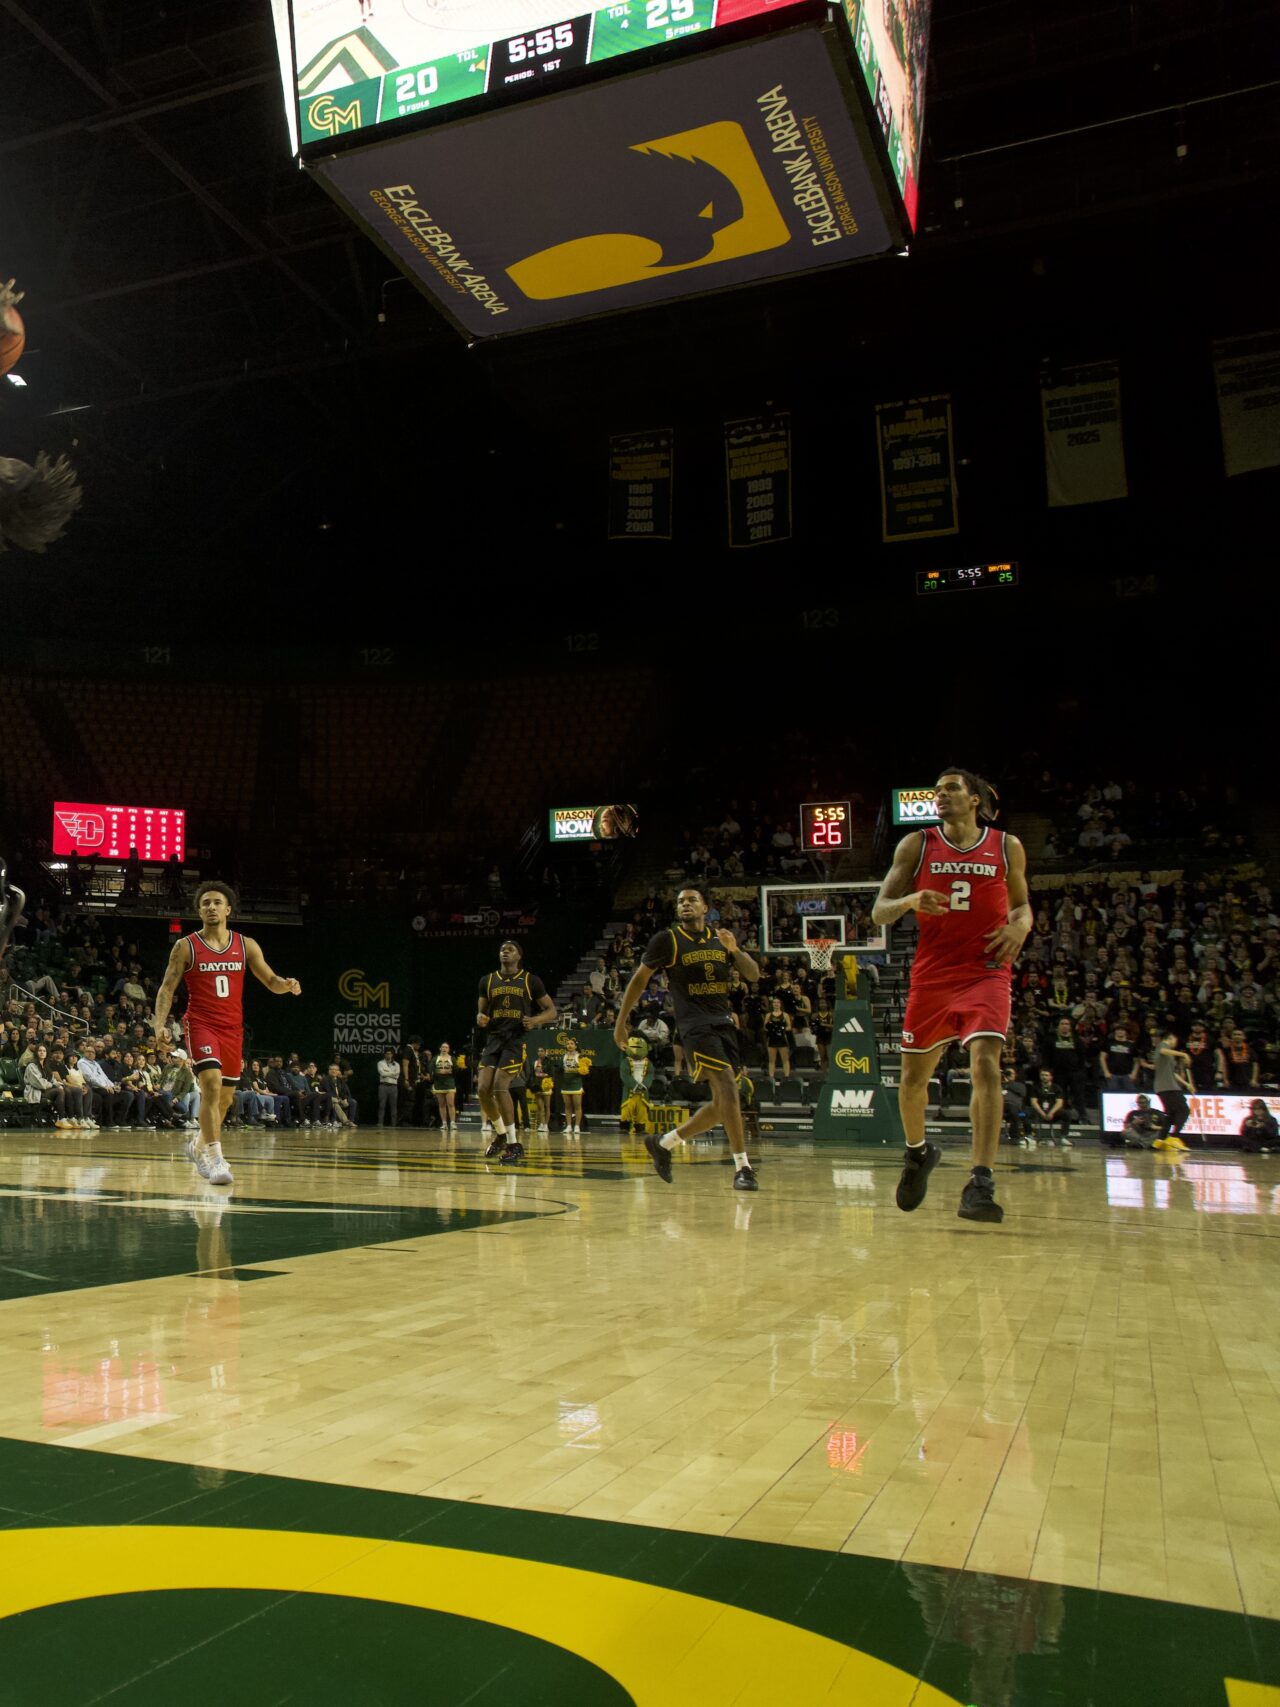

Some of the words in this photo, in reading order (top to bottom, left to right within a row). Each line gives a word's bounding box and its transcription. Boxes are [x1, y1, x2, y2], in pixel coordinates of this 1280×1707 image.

[620, 19, 628, 29] 4
[665, 28, 673, 39] 5
[674, 22, 701, 34] FOULS
[508, 23, 574, 63] 5:55
[468, 64, 476, 72] 4
[504, 69, 535, 84] PERIOD:
[542, 59, 561, 73] 1ST
[396, 66, 438, 103] 20
[756, 84, 806, 153] ARENA
[801, 115, 834, 173] UNIVERSITY
[824, 170, 846, 204] MASON
[782, 151, 843, 247] EAGLEBANK
[835, 201, 859, 236] GEORGE
[369, 189, 406, 226] GEORGE
[399, 226, 432, 255] MASON
[424, 253, 468, 295] UNIVERSITY
[383, 184, 474, 272] EAGLEBANK
[457, 273, 509, 315] ARENA
[924, 580, 938, 590] 20
[999, 572, 1013, 583] 25
[957, 567, 982, 579] 5:55
[800, 607, 840, 630] 123
[143, 646, 171, 665] 121
[556, 811, 593, 820] MASON
[815, 807, 845, 821] 5:55
[556, 820, 593, 834] NOW
[813, 822, 841, 845] 26
[930, 862, 997, 877] DAYTON
[950, 880, 971, 911] 2
[199, 962, 242, 972] DAYTON
[682, 949, 726, 966] GEORGE
[704, 962, 715, 980] 2
[215, 975, 230, 998] 0
[338, 968, 390, 1009] GM
[502, 996, 511, 1008] 4
[334, 1013, 401, 1026] GEORGE
[333, 1028, 401, 1042] MASON
[835, 1048, 869, 1074] GM
[831, 1089, 874, 1108] NW
